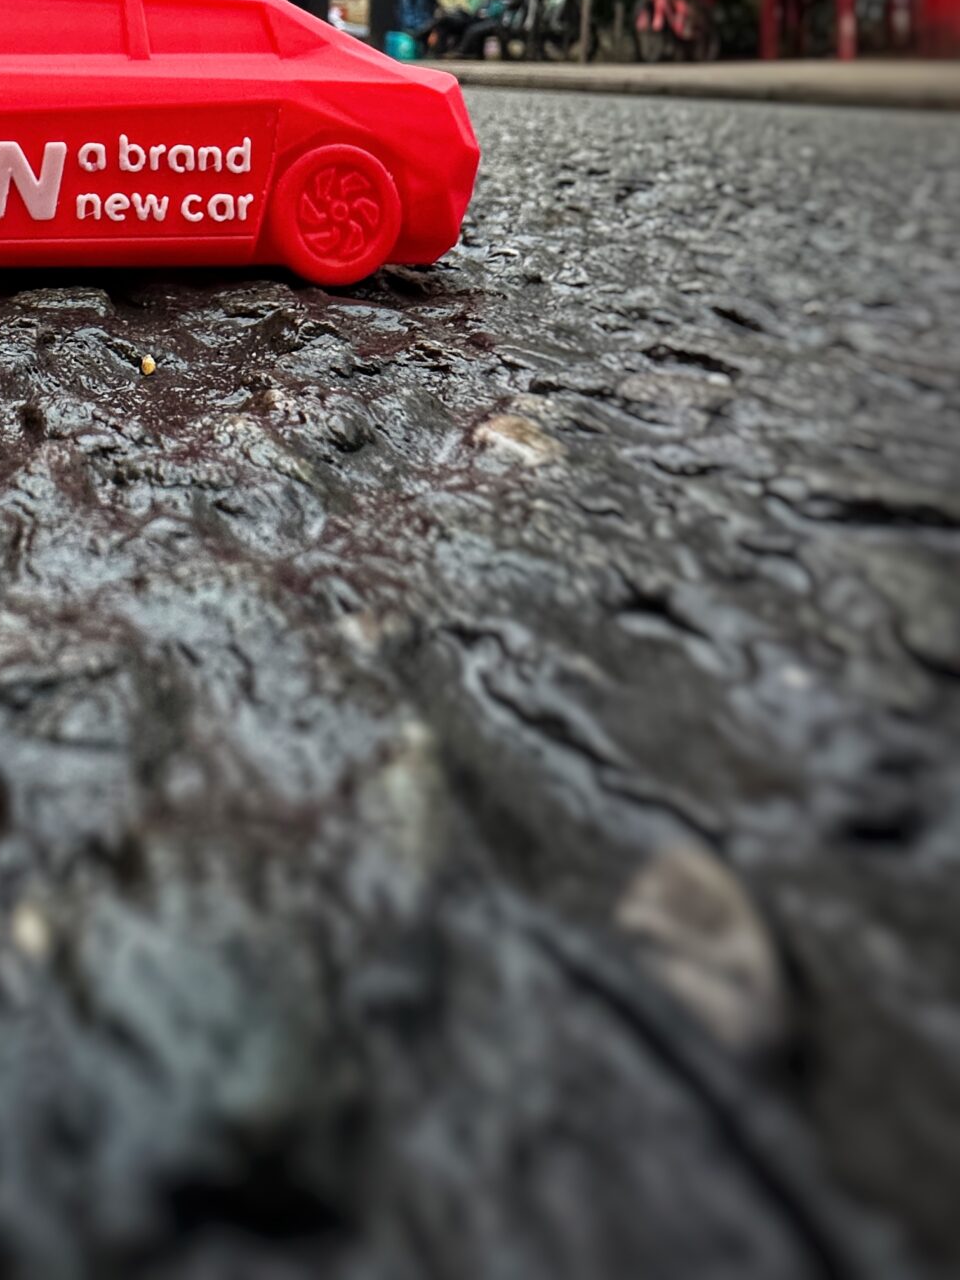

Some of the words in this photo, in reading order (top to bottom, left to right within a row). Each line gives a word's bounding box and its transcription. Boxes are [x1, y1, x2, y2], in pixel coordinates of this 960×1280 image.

[77, 142, 107, 172] a
[119, 133, 252, 174] brand
[76, 192, 170, 221] new
[180, 193, 254, 222] car
